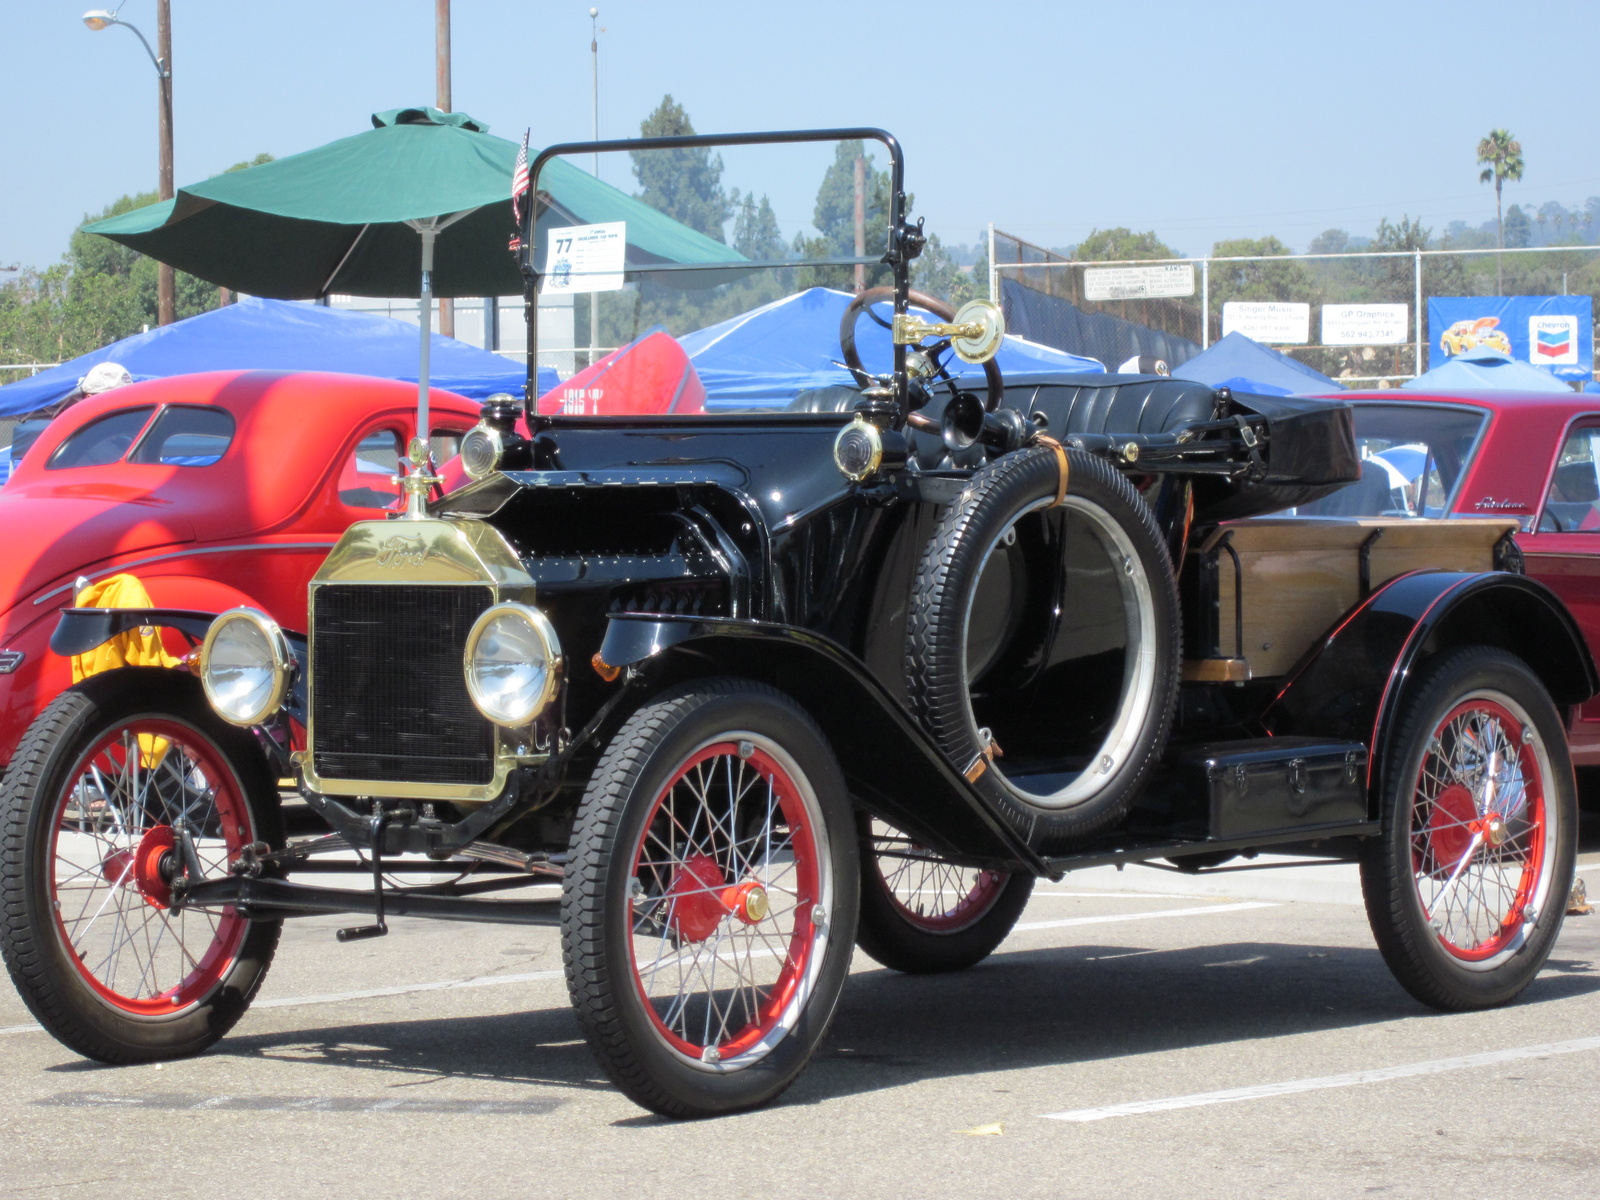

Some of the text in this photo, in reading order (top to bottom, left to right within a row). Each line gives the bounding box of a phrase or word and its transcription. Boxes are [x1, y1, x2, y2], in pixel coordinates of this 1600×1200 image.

[556, 238, 573, 254] 77
[1238, 304, 1294, 314] Singer Music
[1340, 310, 1395, 319] GP Graphics
[1537, 321, 1570, 329] Chevron
[376, 534, 430, 567] Ford
